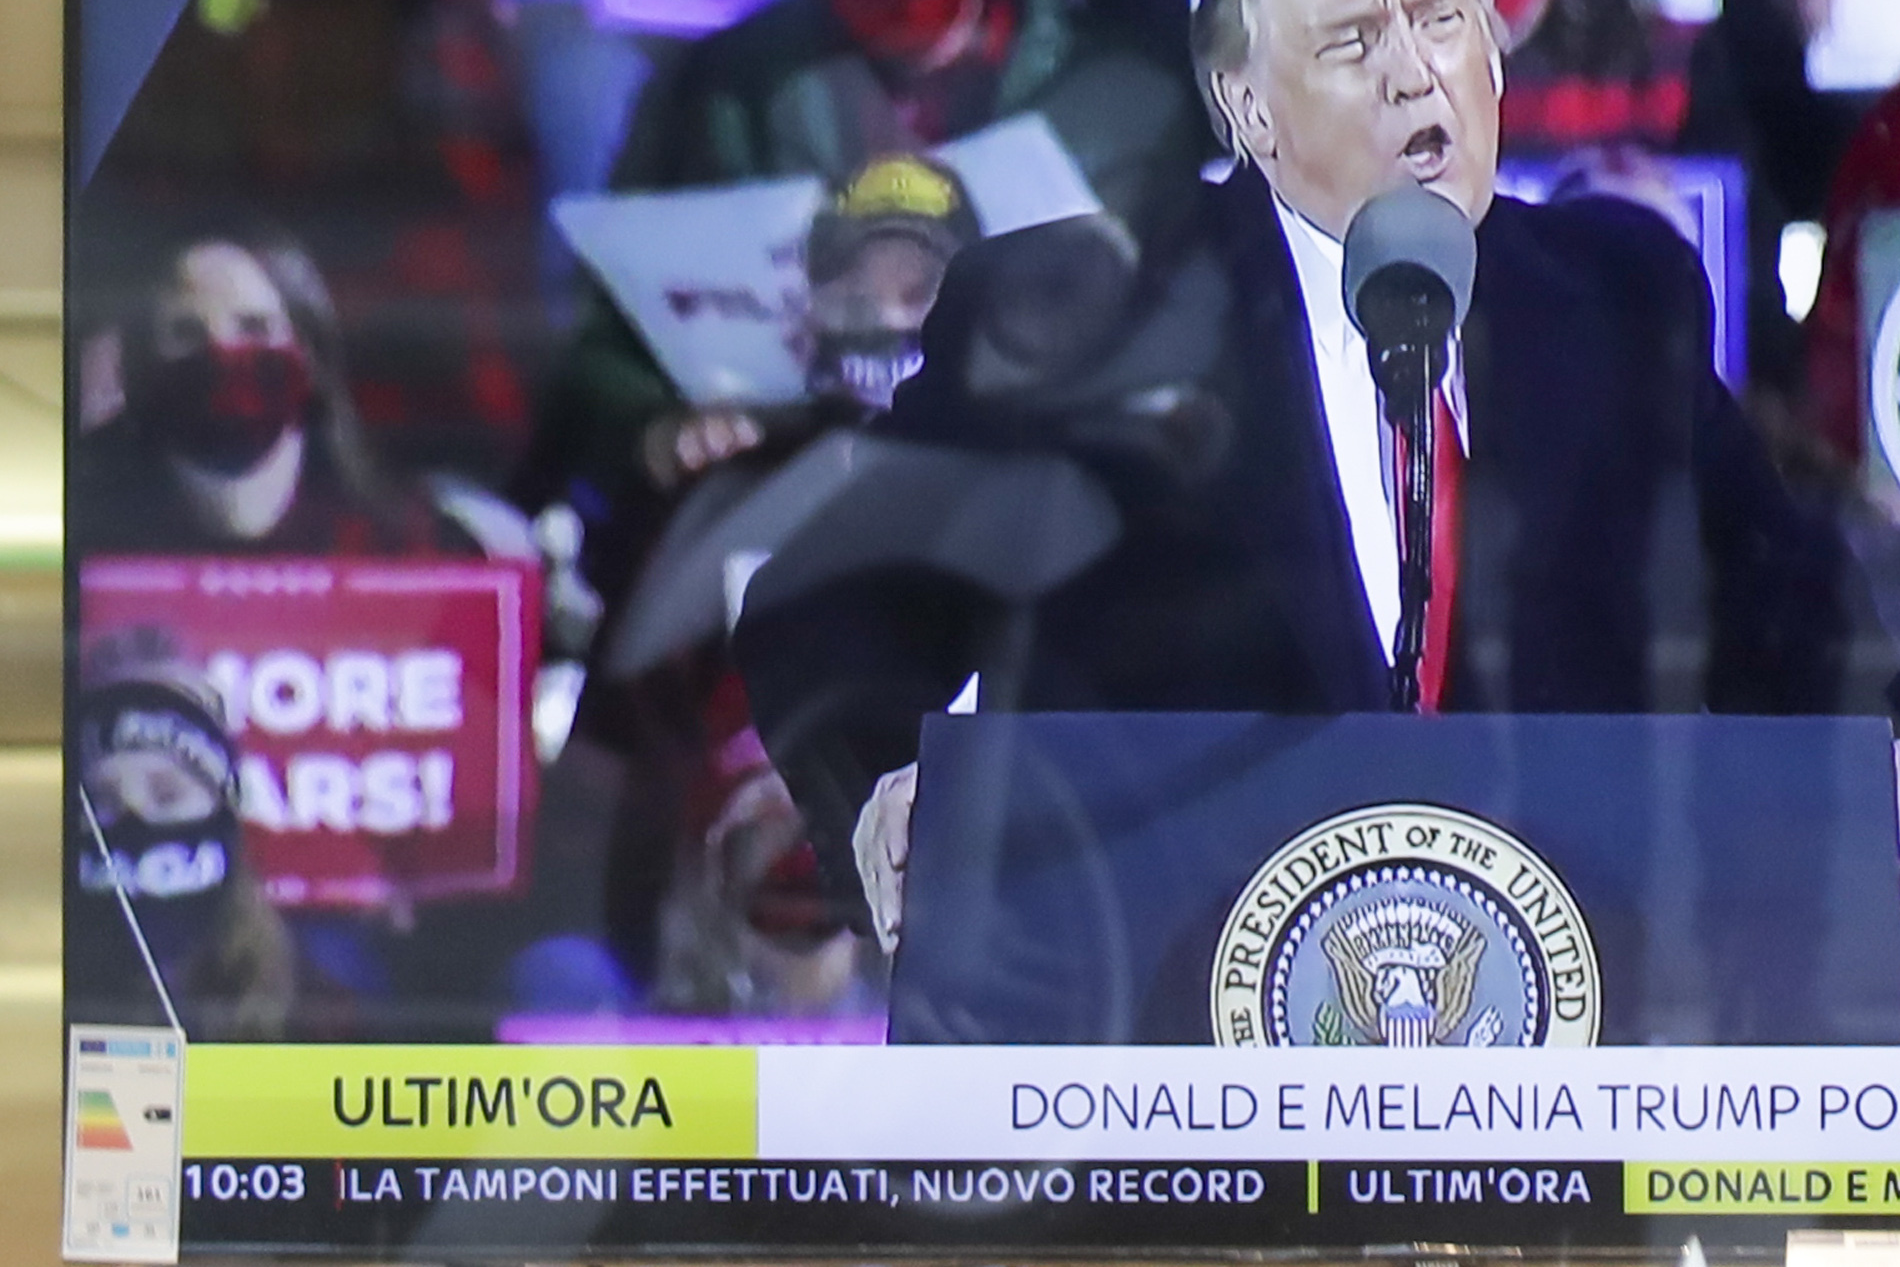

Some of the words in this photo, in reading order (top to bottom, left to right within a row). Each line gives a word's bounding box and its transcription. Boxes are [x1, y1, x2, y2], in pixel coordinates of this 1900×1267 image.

[238, 749, 455, 834] ARS!
[1225, 821, 1392, 993] PRESIDENT
[1406, 825, 1440, 849] OF
[1450, 831, 1498, 870] THE
[1507, 861, 1587, 1023] UNITED
[333, 1076, 674, 1128] ULTIM'ORA
[1011, 1082, 1259, 1132] DONALD
[1278, 1084, 1306, 1131] E
[1325, 1083, 1584, 1131] MELANIA
[1598, 1083, 1801, 1132] TRUMP
[185, 1164, 306, 1202] 10:03
[414, 1166, 617, 1202] TAMPONI
[632, 1167, 899, 1208] EFFETTUATI,
[913, 1167, 1075, 1203] NUOVO
[1089, 1167, 1265, 1203] RECORD
[1348, 1167, 1592, 1203] ULTIM'ORA
[1647, 1169, 1833, 1203] DONALD
[1847, 1170, 1868, 1202] E
